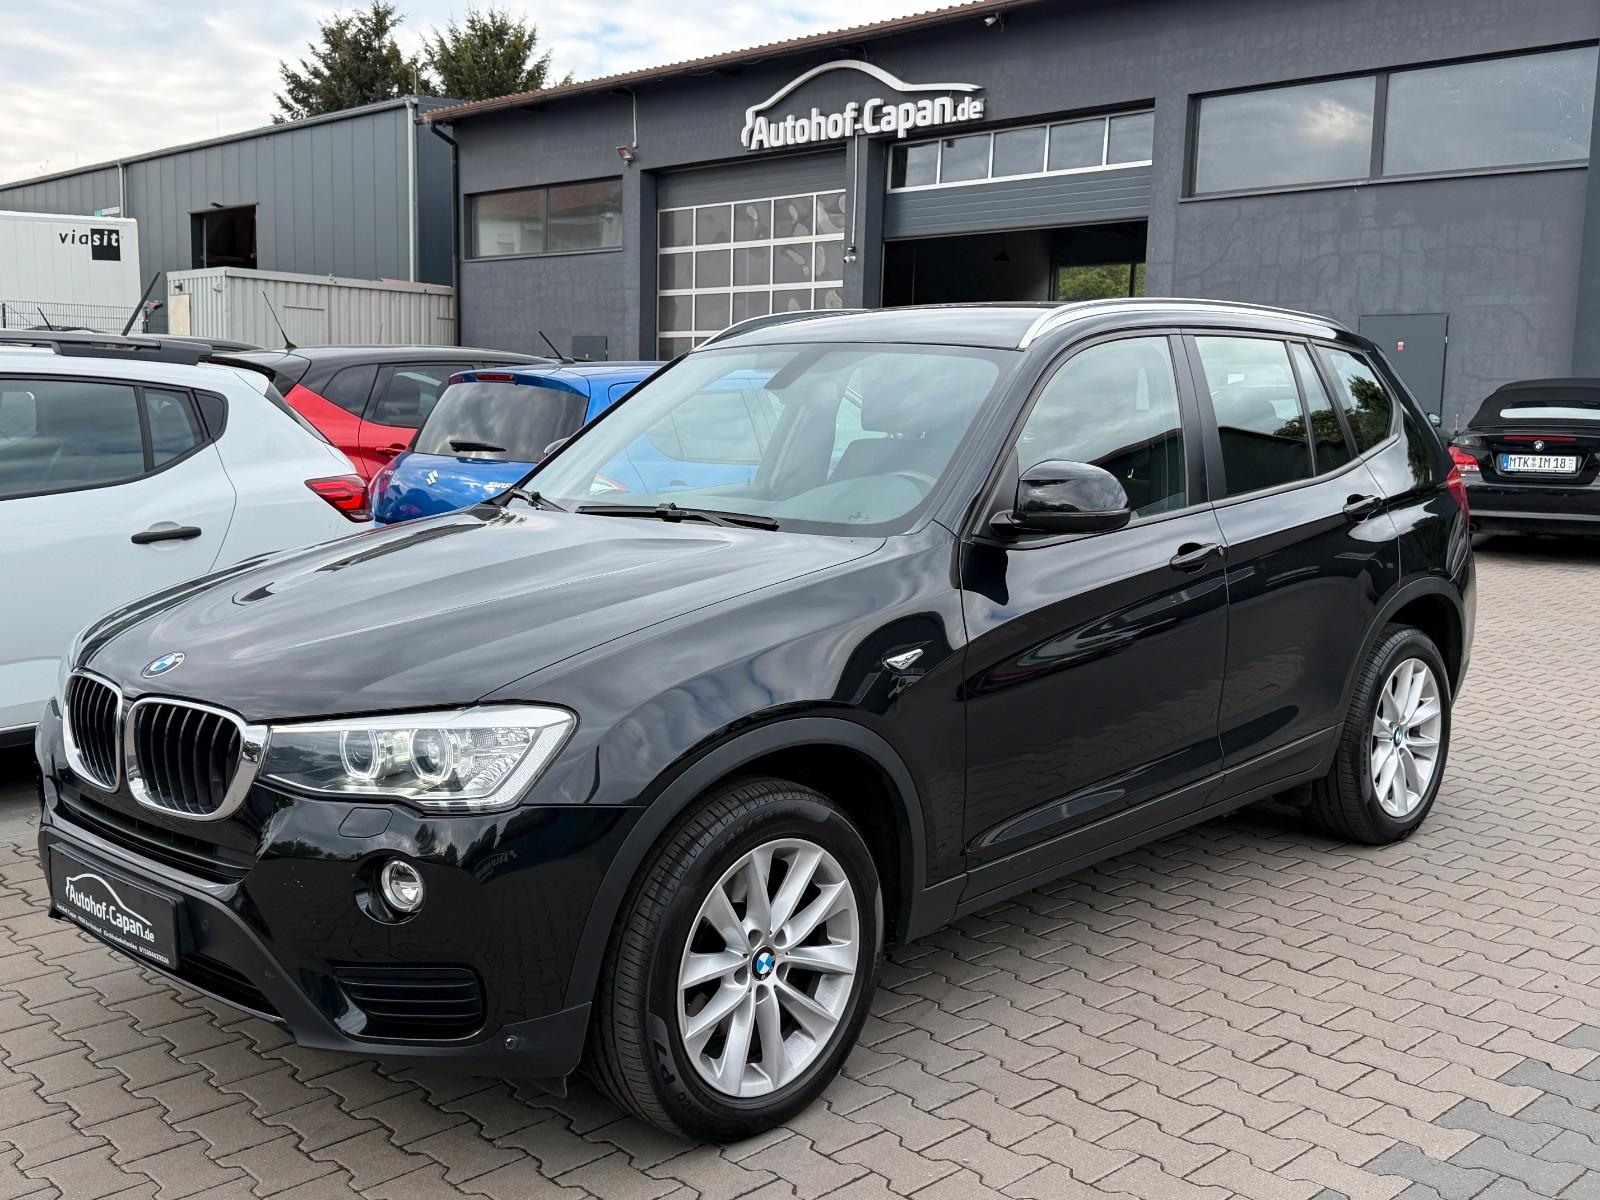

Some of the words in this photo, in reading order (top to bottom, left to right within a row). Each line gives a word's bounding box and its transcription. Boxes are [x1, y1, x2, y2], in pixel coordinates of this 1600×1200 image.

[751, 96, 985, 150] Autohof-Capan.de
[59, 229, 119, 247] viasit
[1509, 456, 1530, 469] MTK
[1538, 457, 1551, 469] IM
[1553, 458, 1566, 469] 18
[488, 481, 513, 490] SWIF
[69, 884, 155, 943] Autohof-Capan.de
